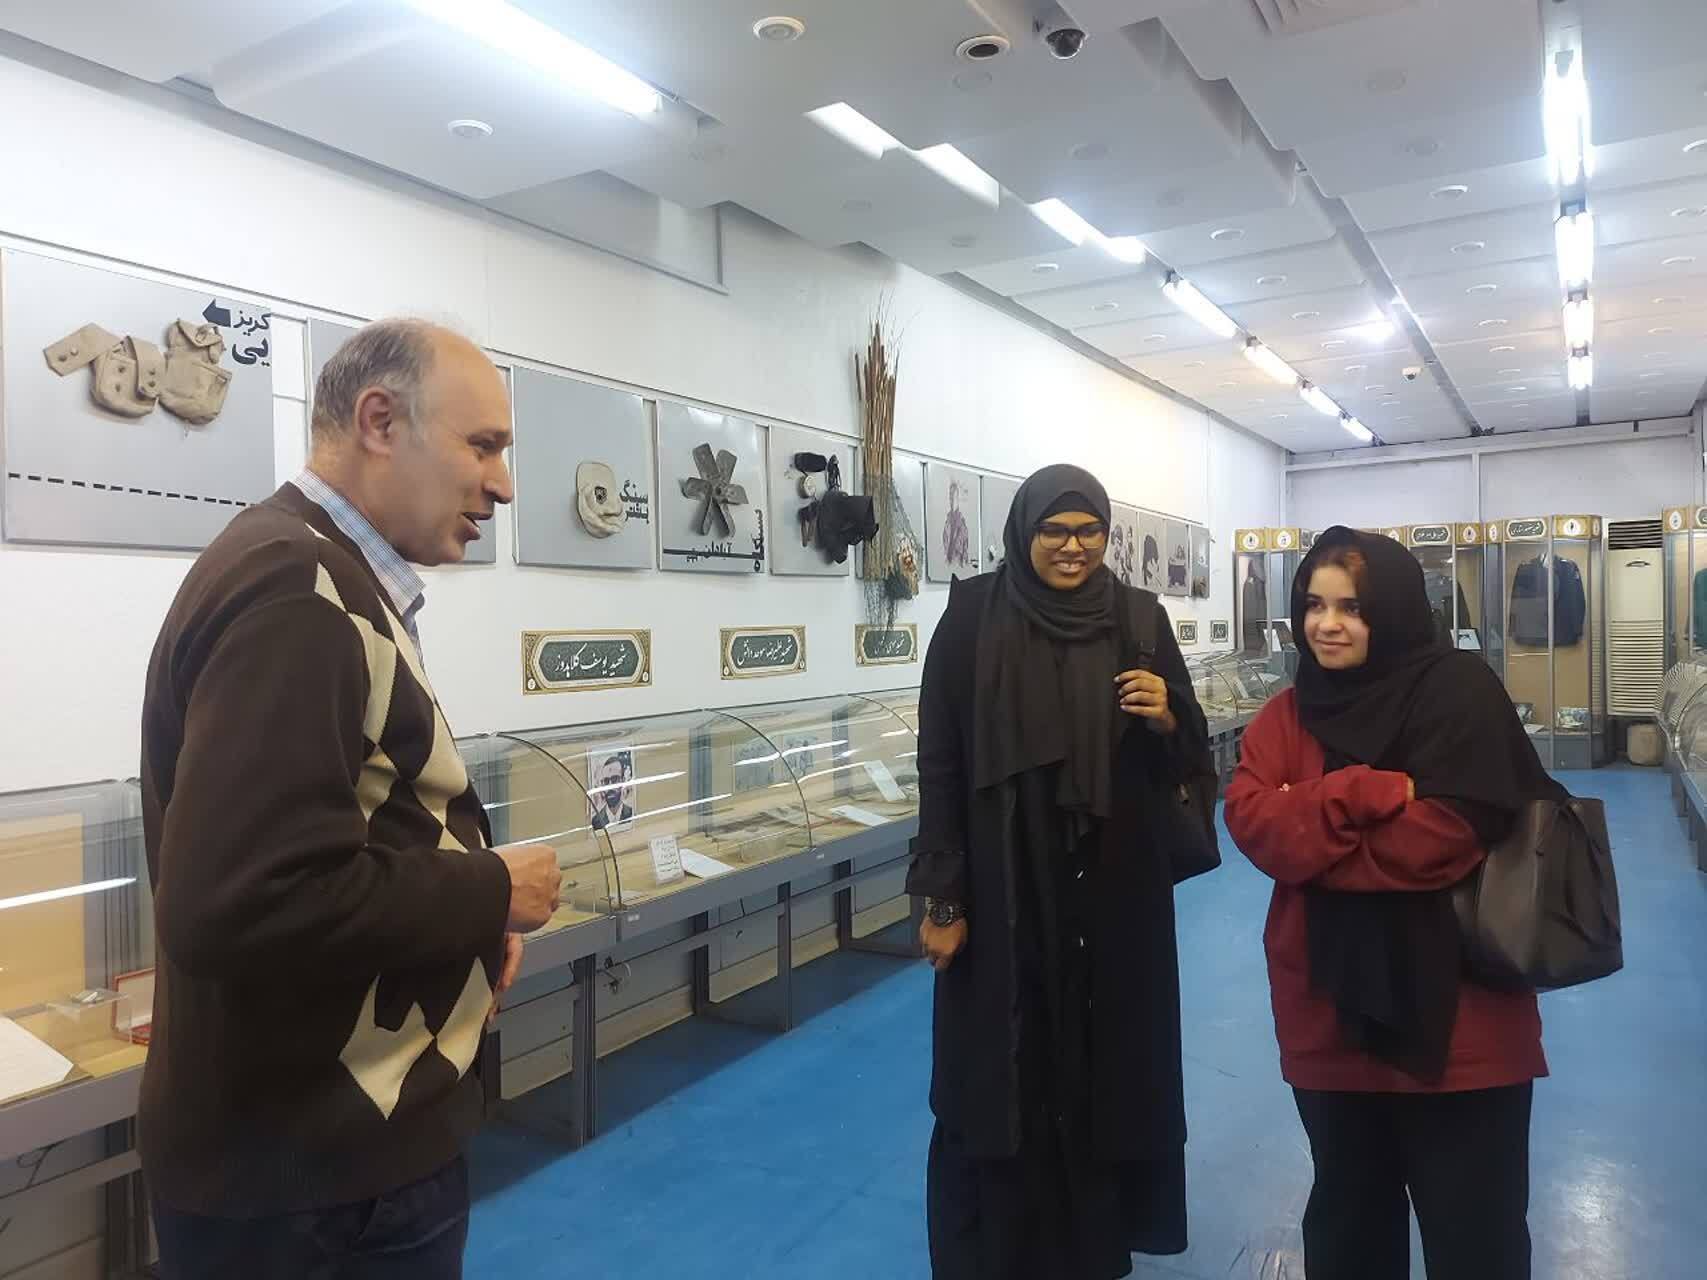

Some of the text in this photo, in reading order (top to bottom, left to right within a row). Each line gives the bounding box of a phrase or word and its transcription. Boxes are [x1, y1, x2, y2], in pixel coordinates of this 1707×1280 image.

[608, 643, 629, 677] شهید
[779, 635, 793, 663] شهید
[580, 651, 609, 676] یوسف
